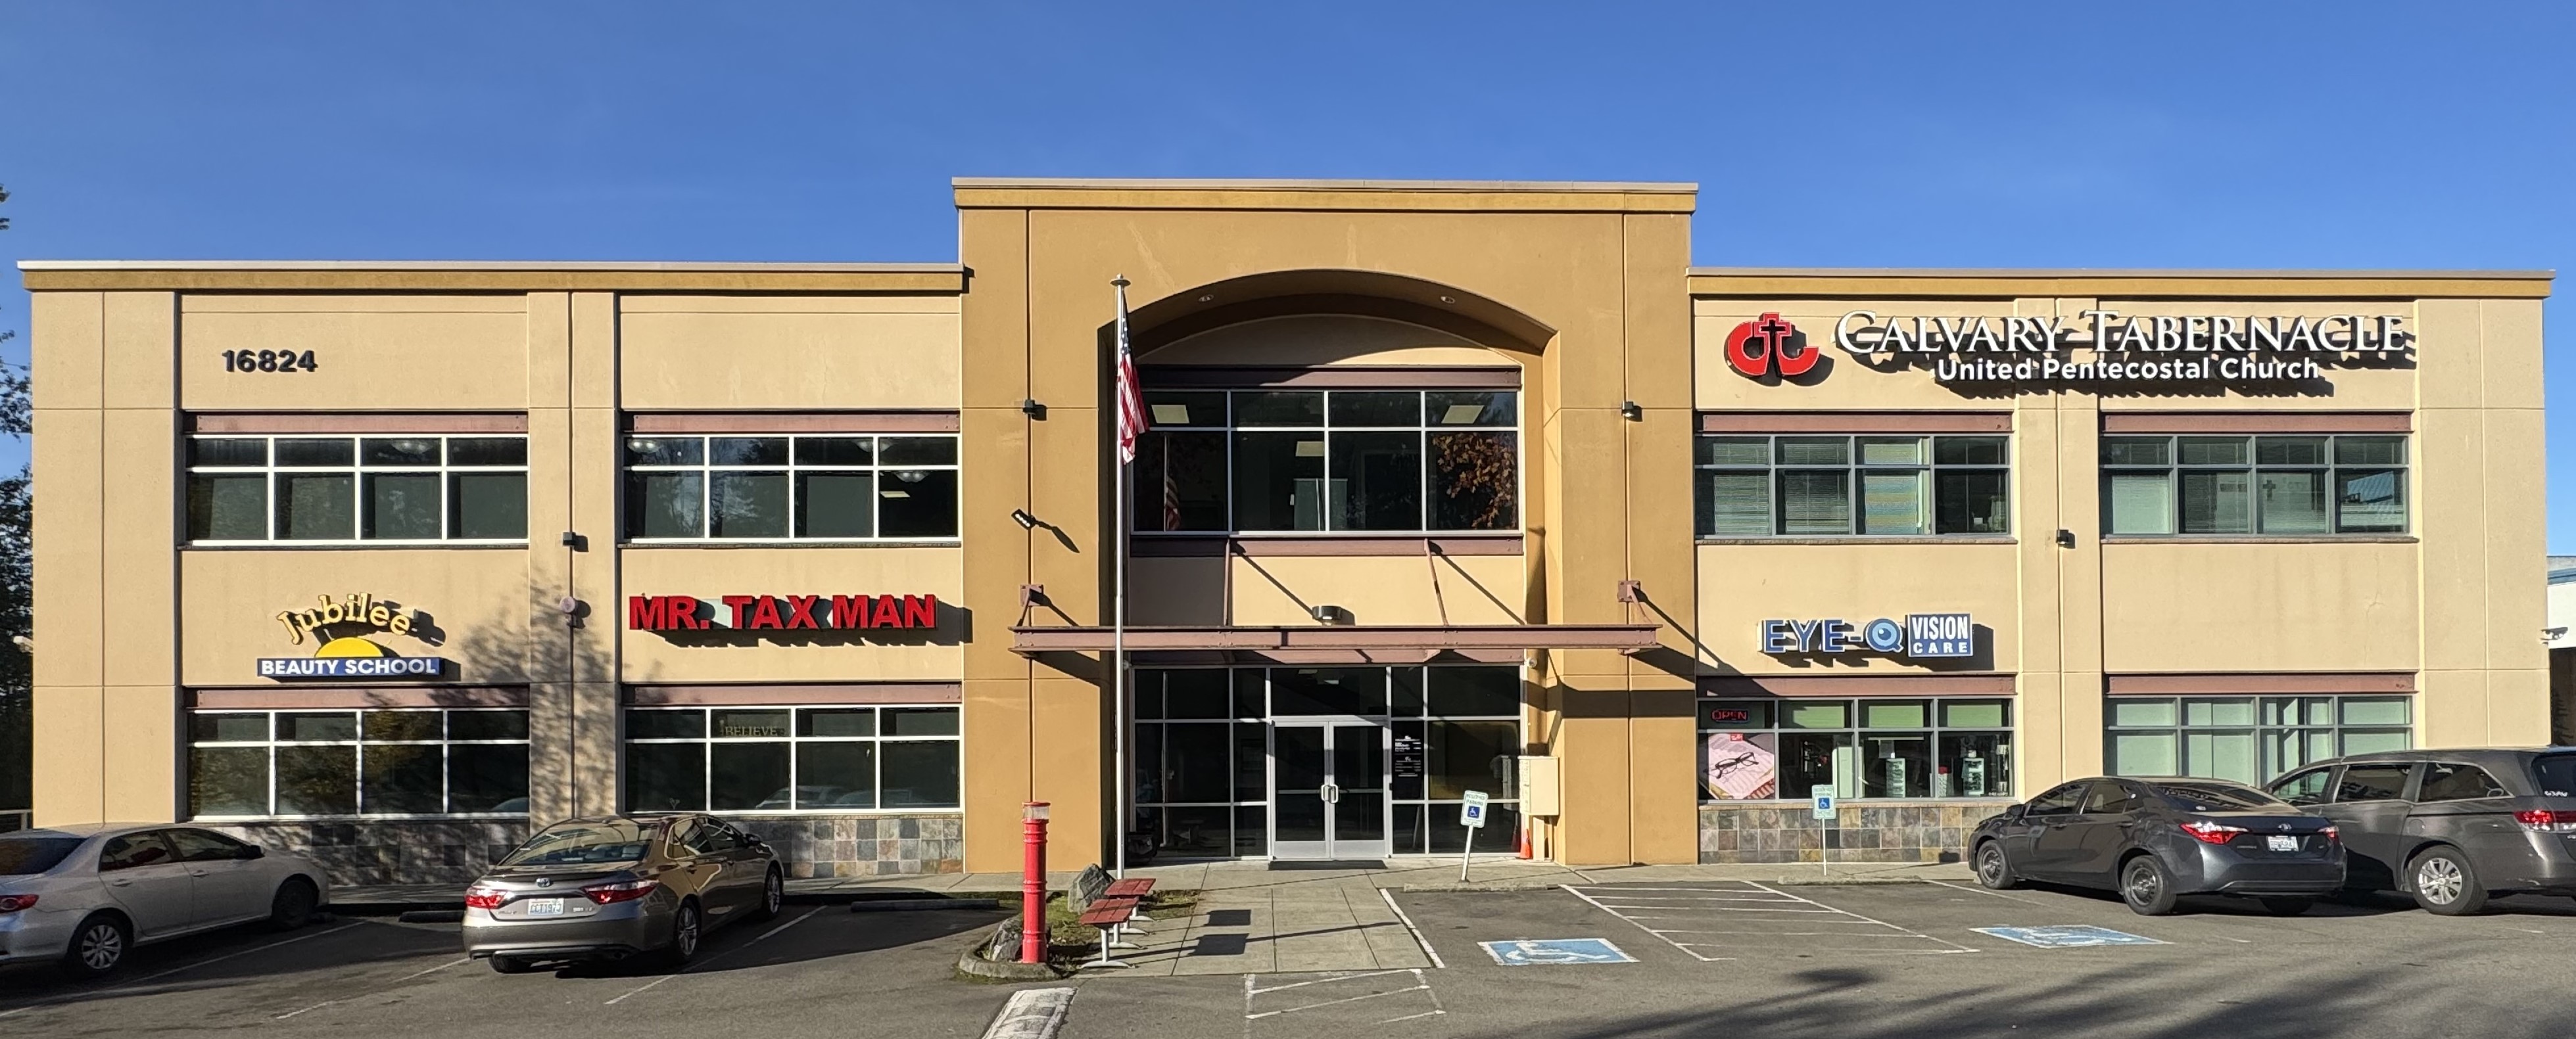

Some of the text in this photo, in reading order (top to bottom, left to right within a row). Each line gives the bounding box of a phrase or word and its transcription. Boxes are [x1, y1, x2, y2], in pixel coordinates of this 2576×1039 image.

[1837, 310, 2406, 354] CALVARY TABERNACLE
[222, 350, 318, 373] 16824
[1938, 357, 2320, 380] United Pentecostal Church
[276, 592, 410, 645] Jubilee
[629, 594, 938, 630] MR. TAX MAN
[1764, 618, 1903, 653] EYE-Q
[1911, 616, 1968, 640] VISION
[1913, 641, 1968, 654] CARE
[262, 659, 437, 675] BEAUTY SCHOOL
[725, 726, 778, 737] BELIEVE
